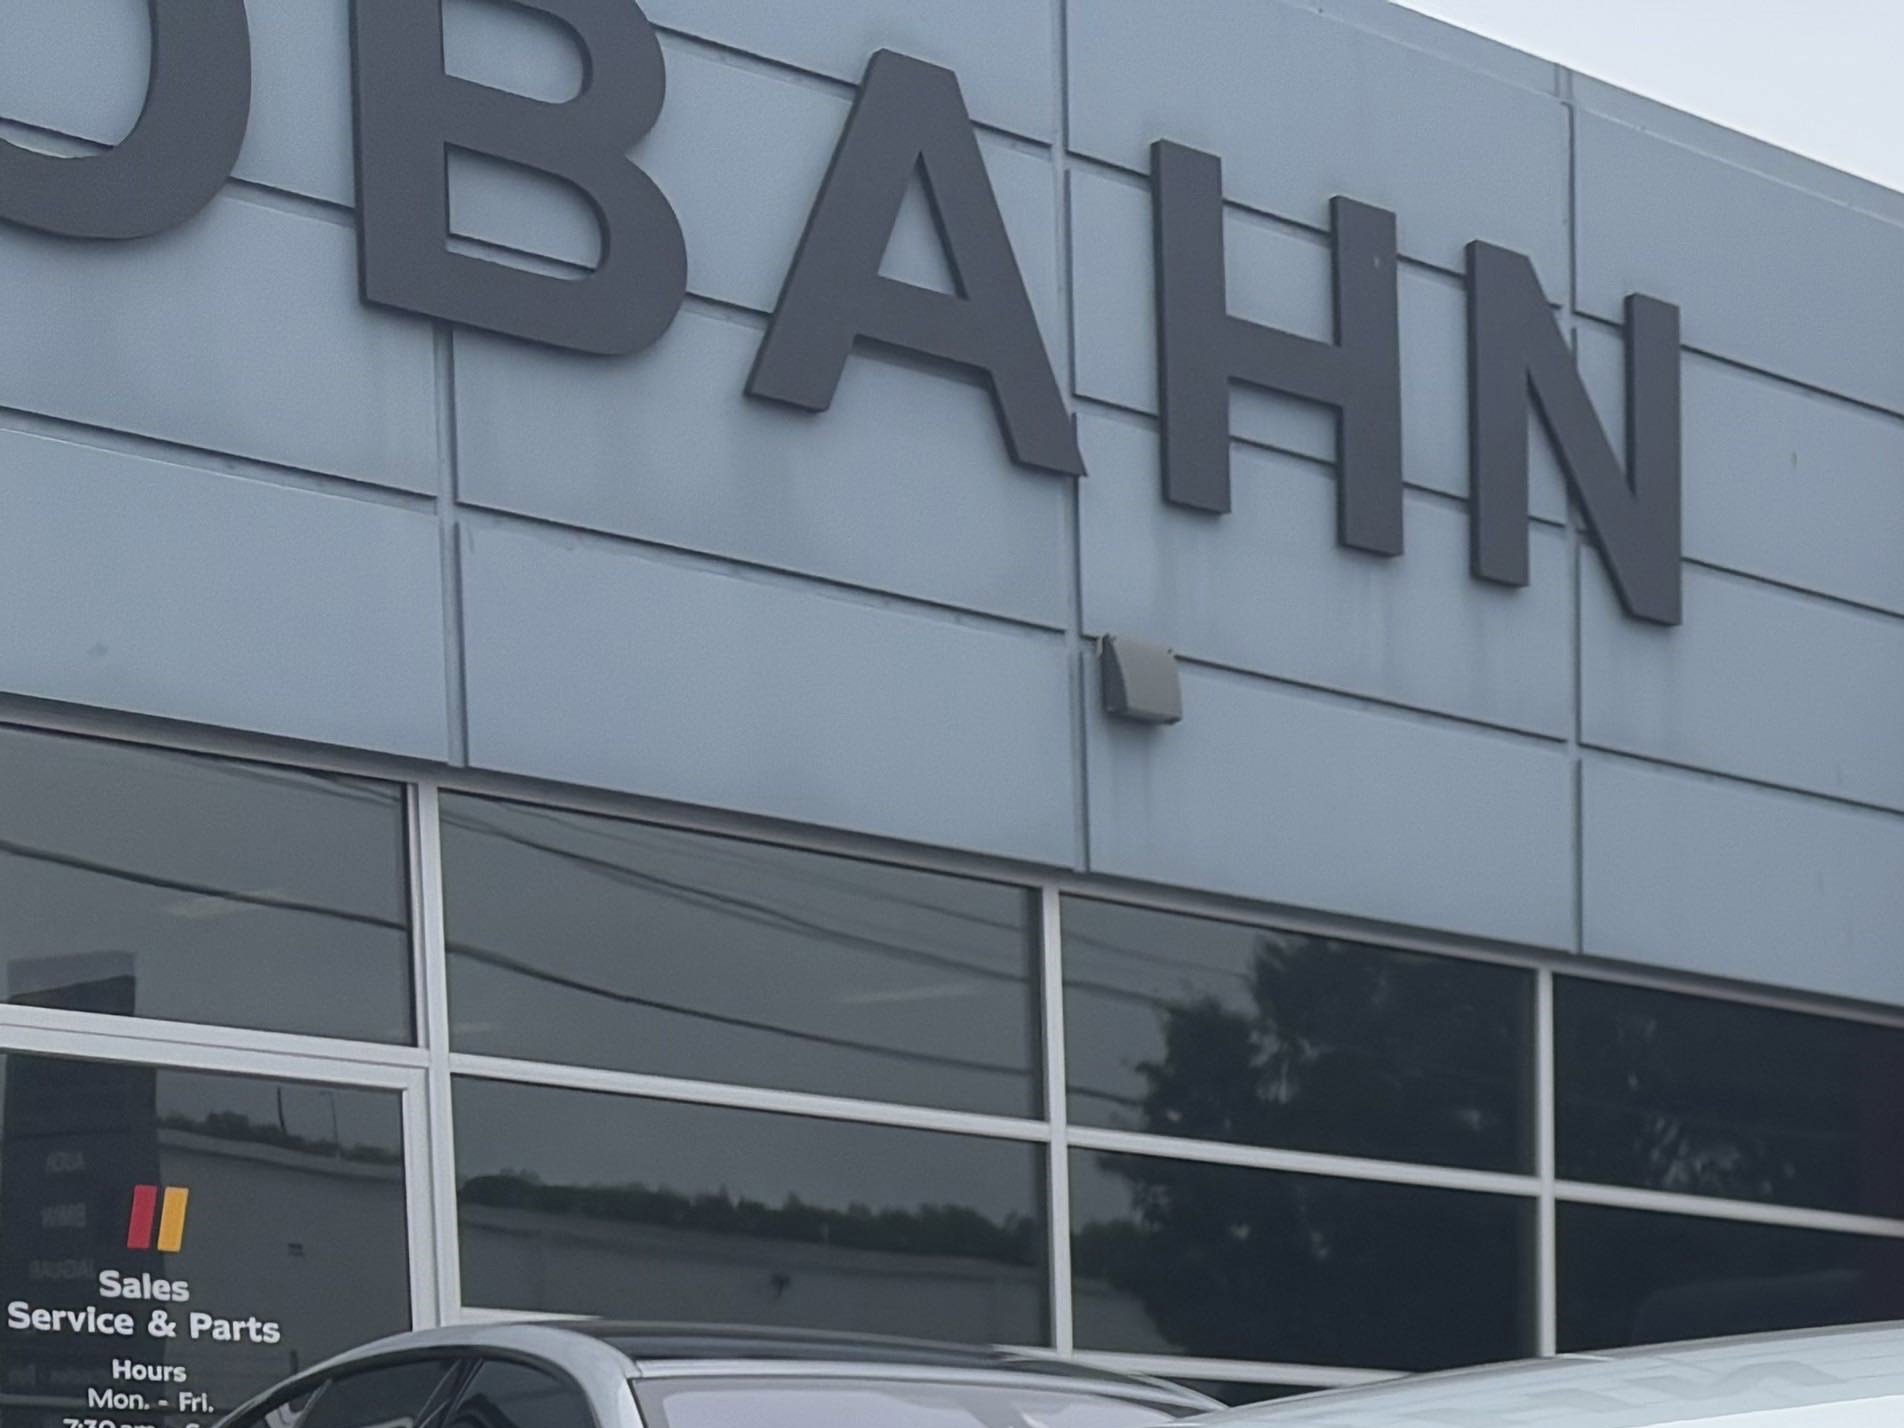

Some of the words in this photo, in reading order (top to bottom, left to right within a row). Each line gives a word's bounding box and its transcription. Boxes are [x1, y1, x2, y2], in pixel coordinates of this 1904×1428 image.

[98, 1269, 191, 1303] Sales
[7, 1301, 135, 1336] Service
[147, 1310, 177, 1339] &
[189, 1312, 282, 1344] Parts
[111, 1358, 188, 1383] Hours
[87, 1387, 151, 1411] Mon.
[178, 1391, 215, 1414] Fri.
